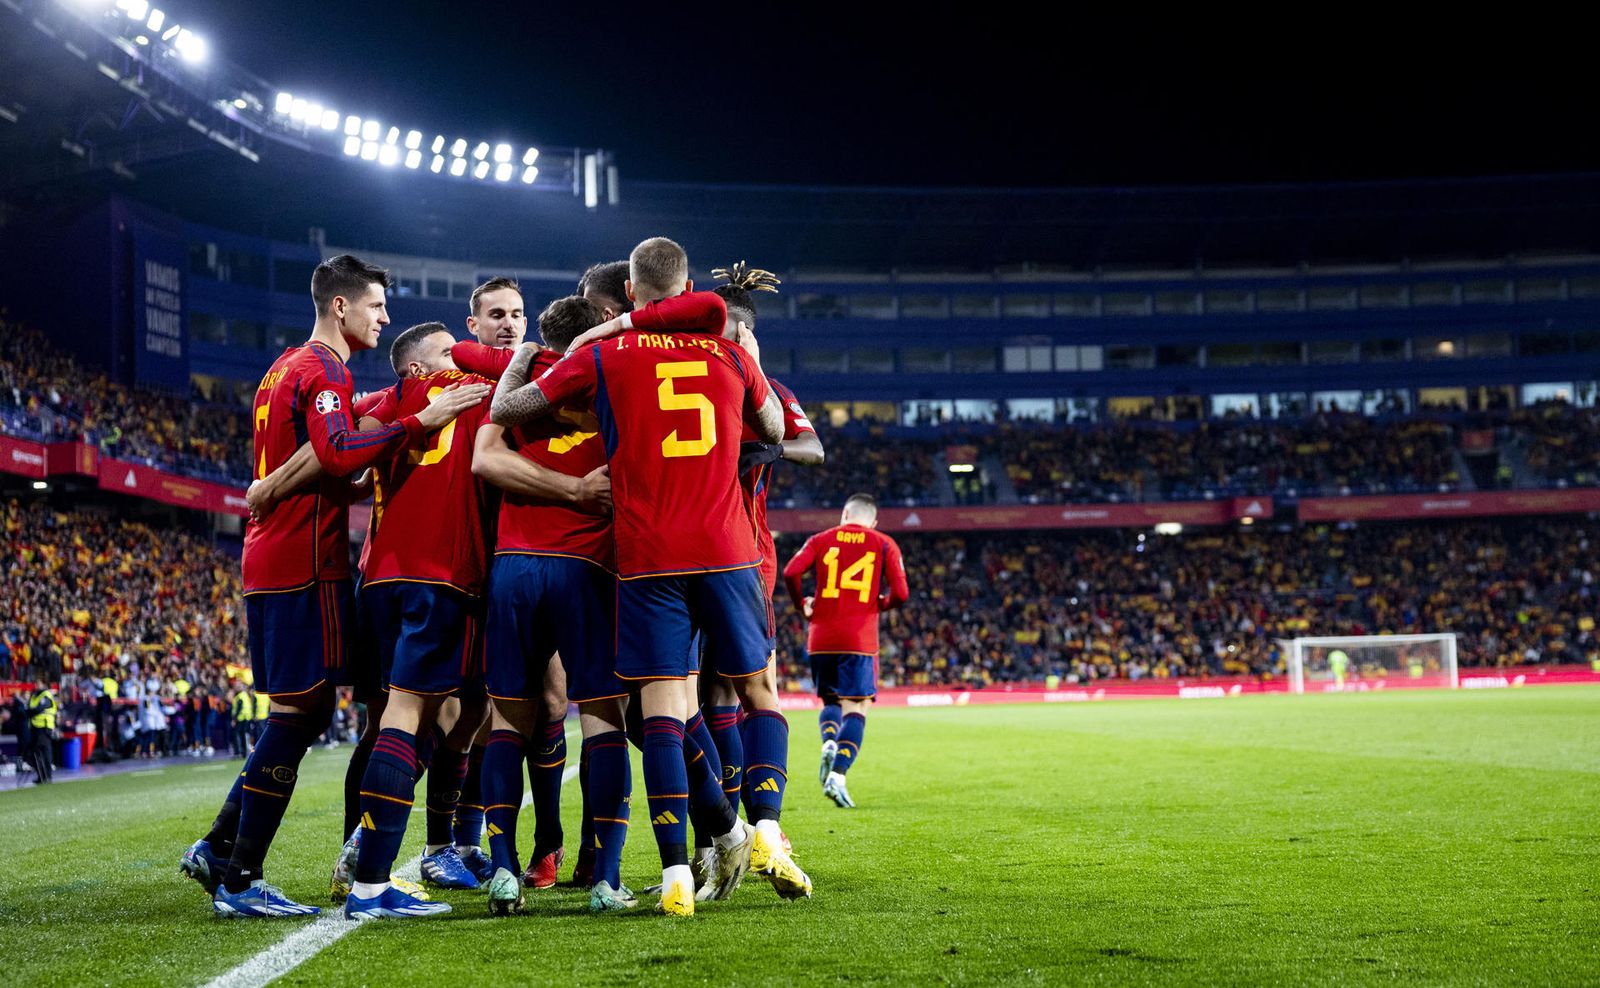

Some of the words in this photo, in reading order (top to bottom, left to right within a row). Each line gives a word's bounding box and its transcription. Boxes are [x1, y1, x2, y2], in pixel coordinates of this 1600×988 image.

[637, 333, 724, 357] MAREZ
[655, 360, 717, 458] 5
[821, 546, 877, 604] 14
